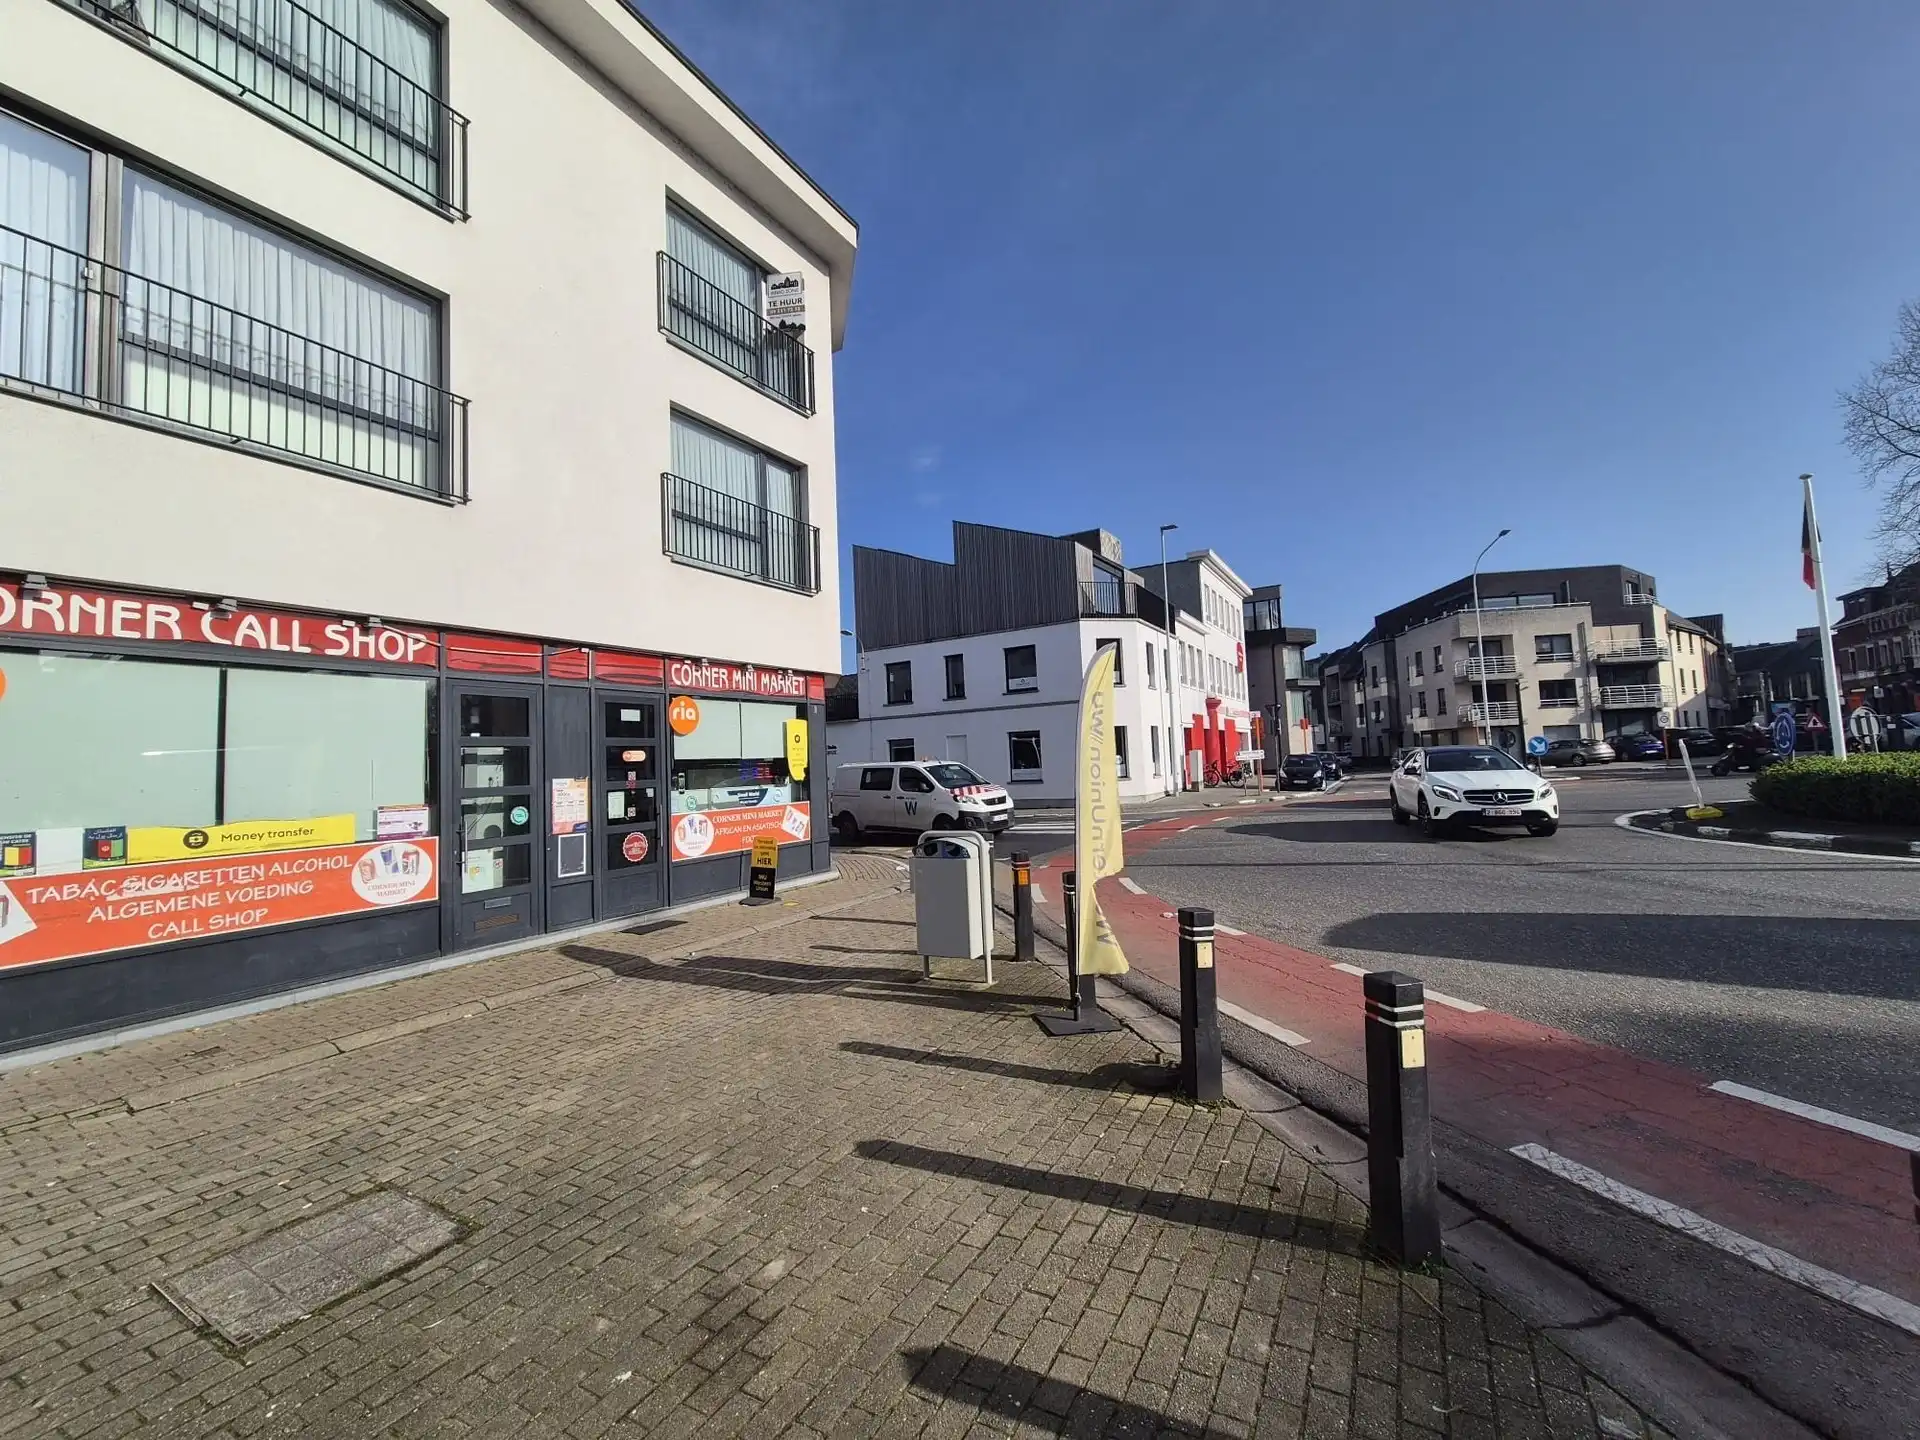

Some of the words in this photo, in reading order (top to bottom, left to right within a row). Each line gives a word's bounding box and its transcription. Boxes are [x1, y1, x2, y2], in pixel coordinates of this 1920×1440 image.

[768, 300, 778, 308] TE
[780, 297, 803, 306] HUUR
[201, 611, 312, 653] CALL
[324, 622, 428, 662] SHOP
[671, 663, 729, 689] CORNER
[761, 674, 805, 695] MARKET
[672, 701, 697, 721] ria
[713, 814, 741, 824] CORNER
[742, 812, 757, 820] MINI
[758, 809, 783, 819] MARKET
[221, 832, 264, 843] Money
[268, 827, 315, 839] transfer
[268, 855, 352, 876] ALCOHOL
[757, 857, 772, 866] HIER
[87, 892, 221, 923] ALGEMENE
[225, 880, 314, 905] VOEDING
[148, 917, 204, 939] CALL
[209, 908, 269, 930] SHOP
